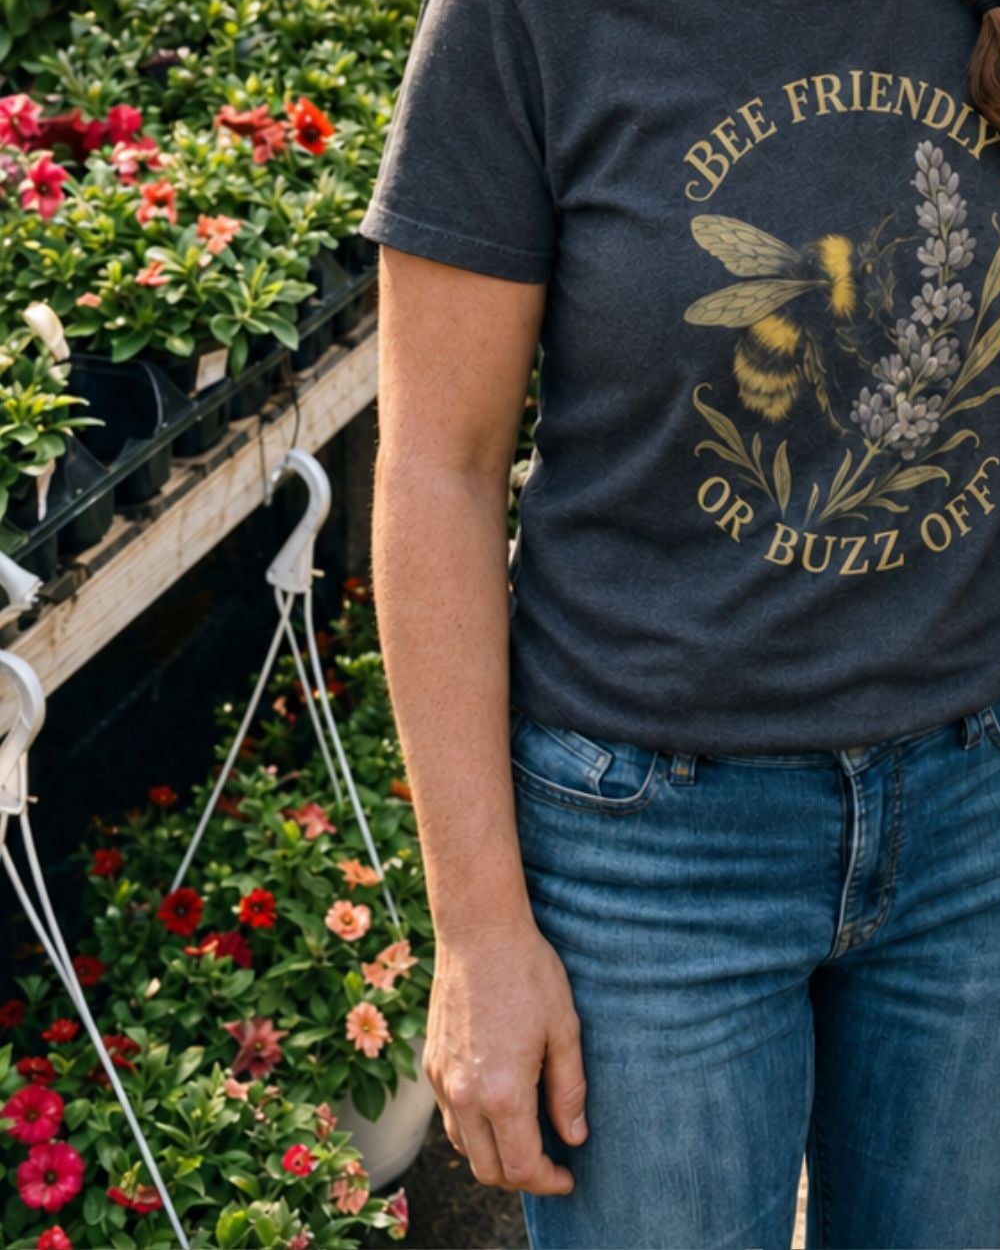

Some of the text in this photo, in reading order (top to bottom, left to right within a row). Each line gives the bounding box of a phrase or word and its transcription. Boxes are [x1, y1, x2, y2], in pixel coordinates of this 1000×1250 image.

[684, 97, 777, 202] BEE
[697, 456, 1000, 576] OR BUZZ OFF
